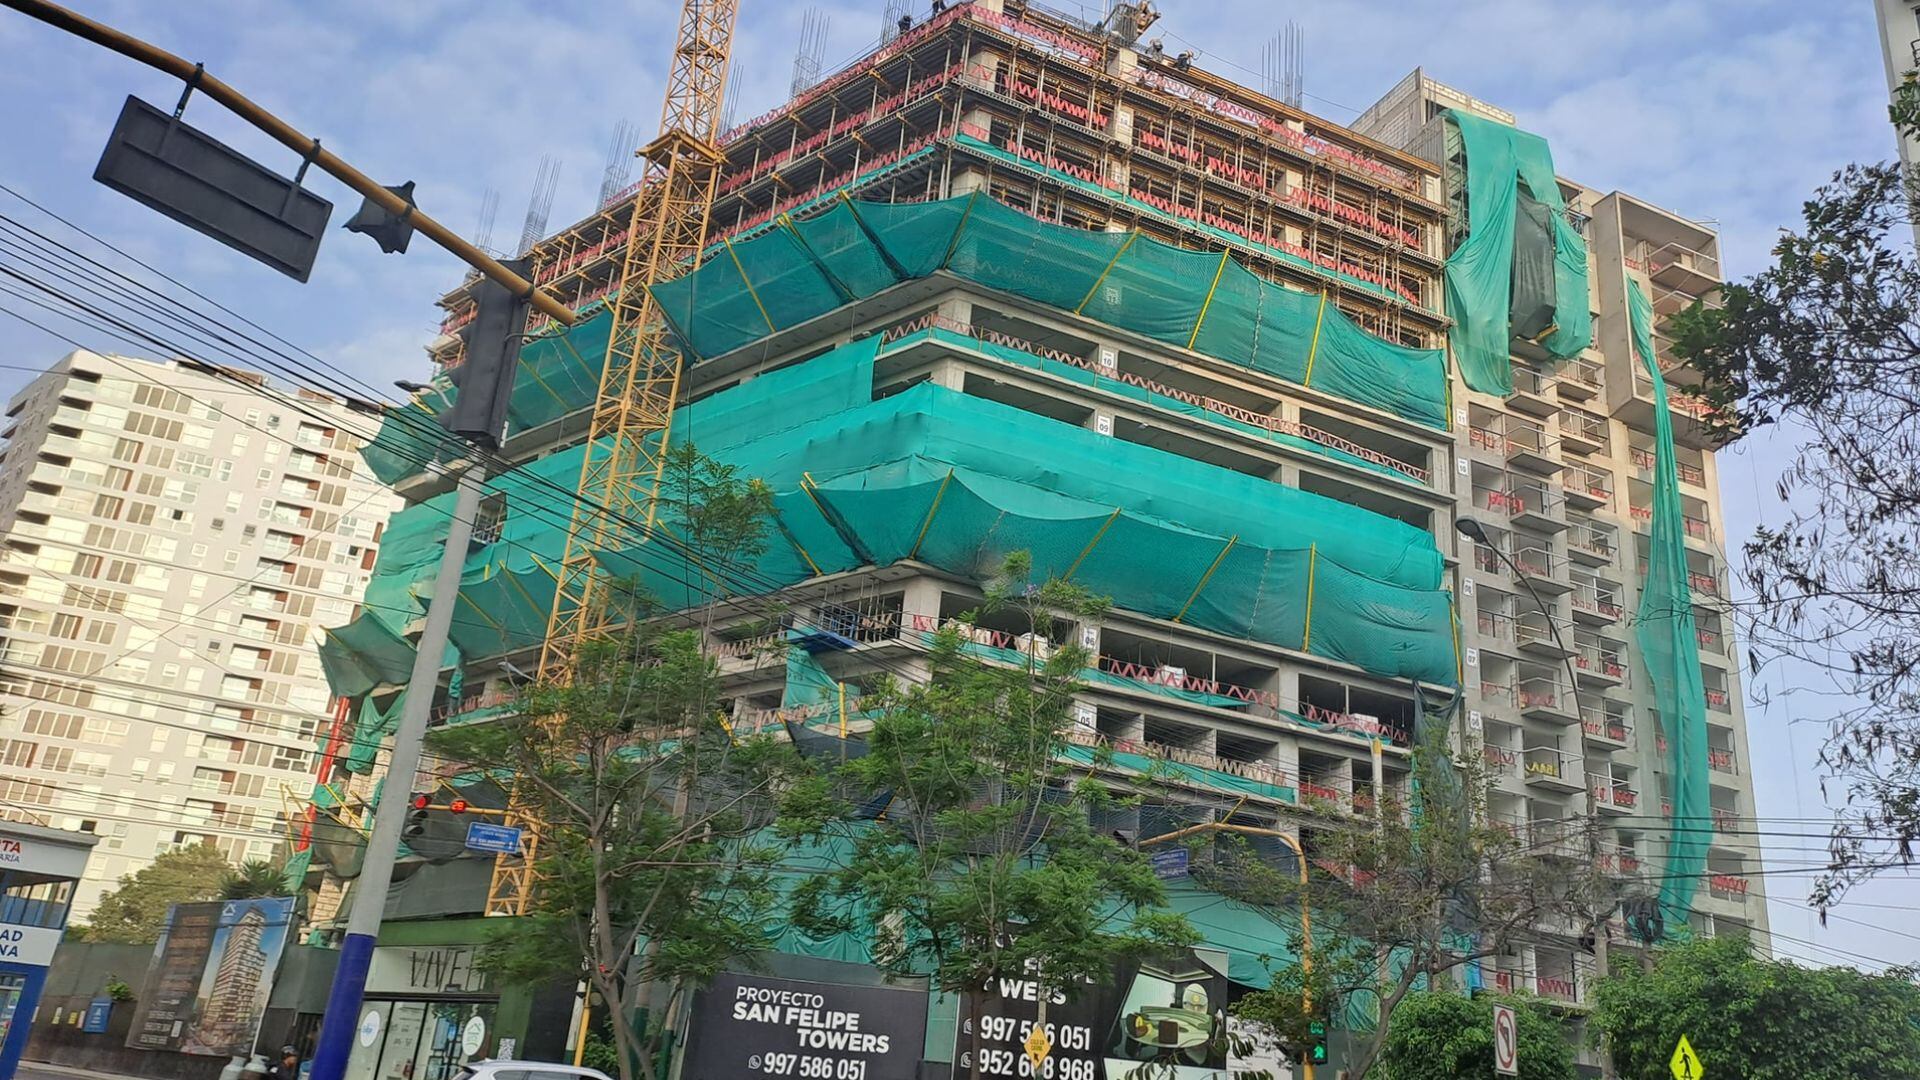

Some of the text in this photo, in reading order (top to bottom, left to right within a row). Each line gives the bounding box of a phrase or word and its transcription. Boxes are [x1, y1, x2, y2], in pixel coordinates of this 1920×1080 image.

[1103, 357, 1112, 366] 10
[1099, 424, 1109, 433] 09
[735, 986, 824, 1009] PROYECTO
[733, 1001, 860, 1032] SAN FELIPE
[797, 1028, 890, 1054] TOWERS
[980, 1015, 1091, 1051] 997 56 051
[763, 1052, 866, 1080] 997 586 051
[979, 1048, 1095, 1080] 952 68 968
